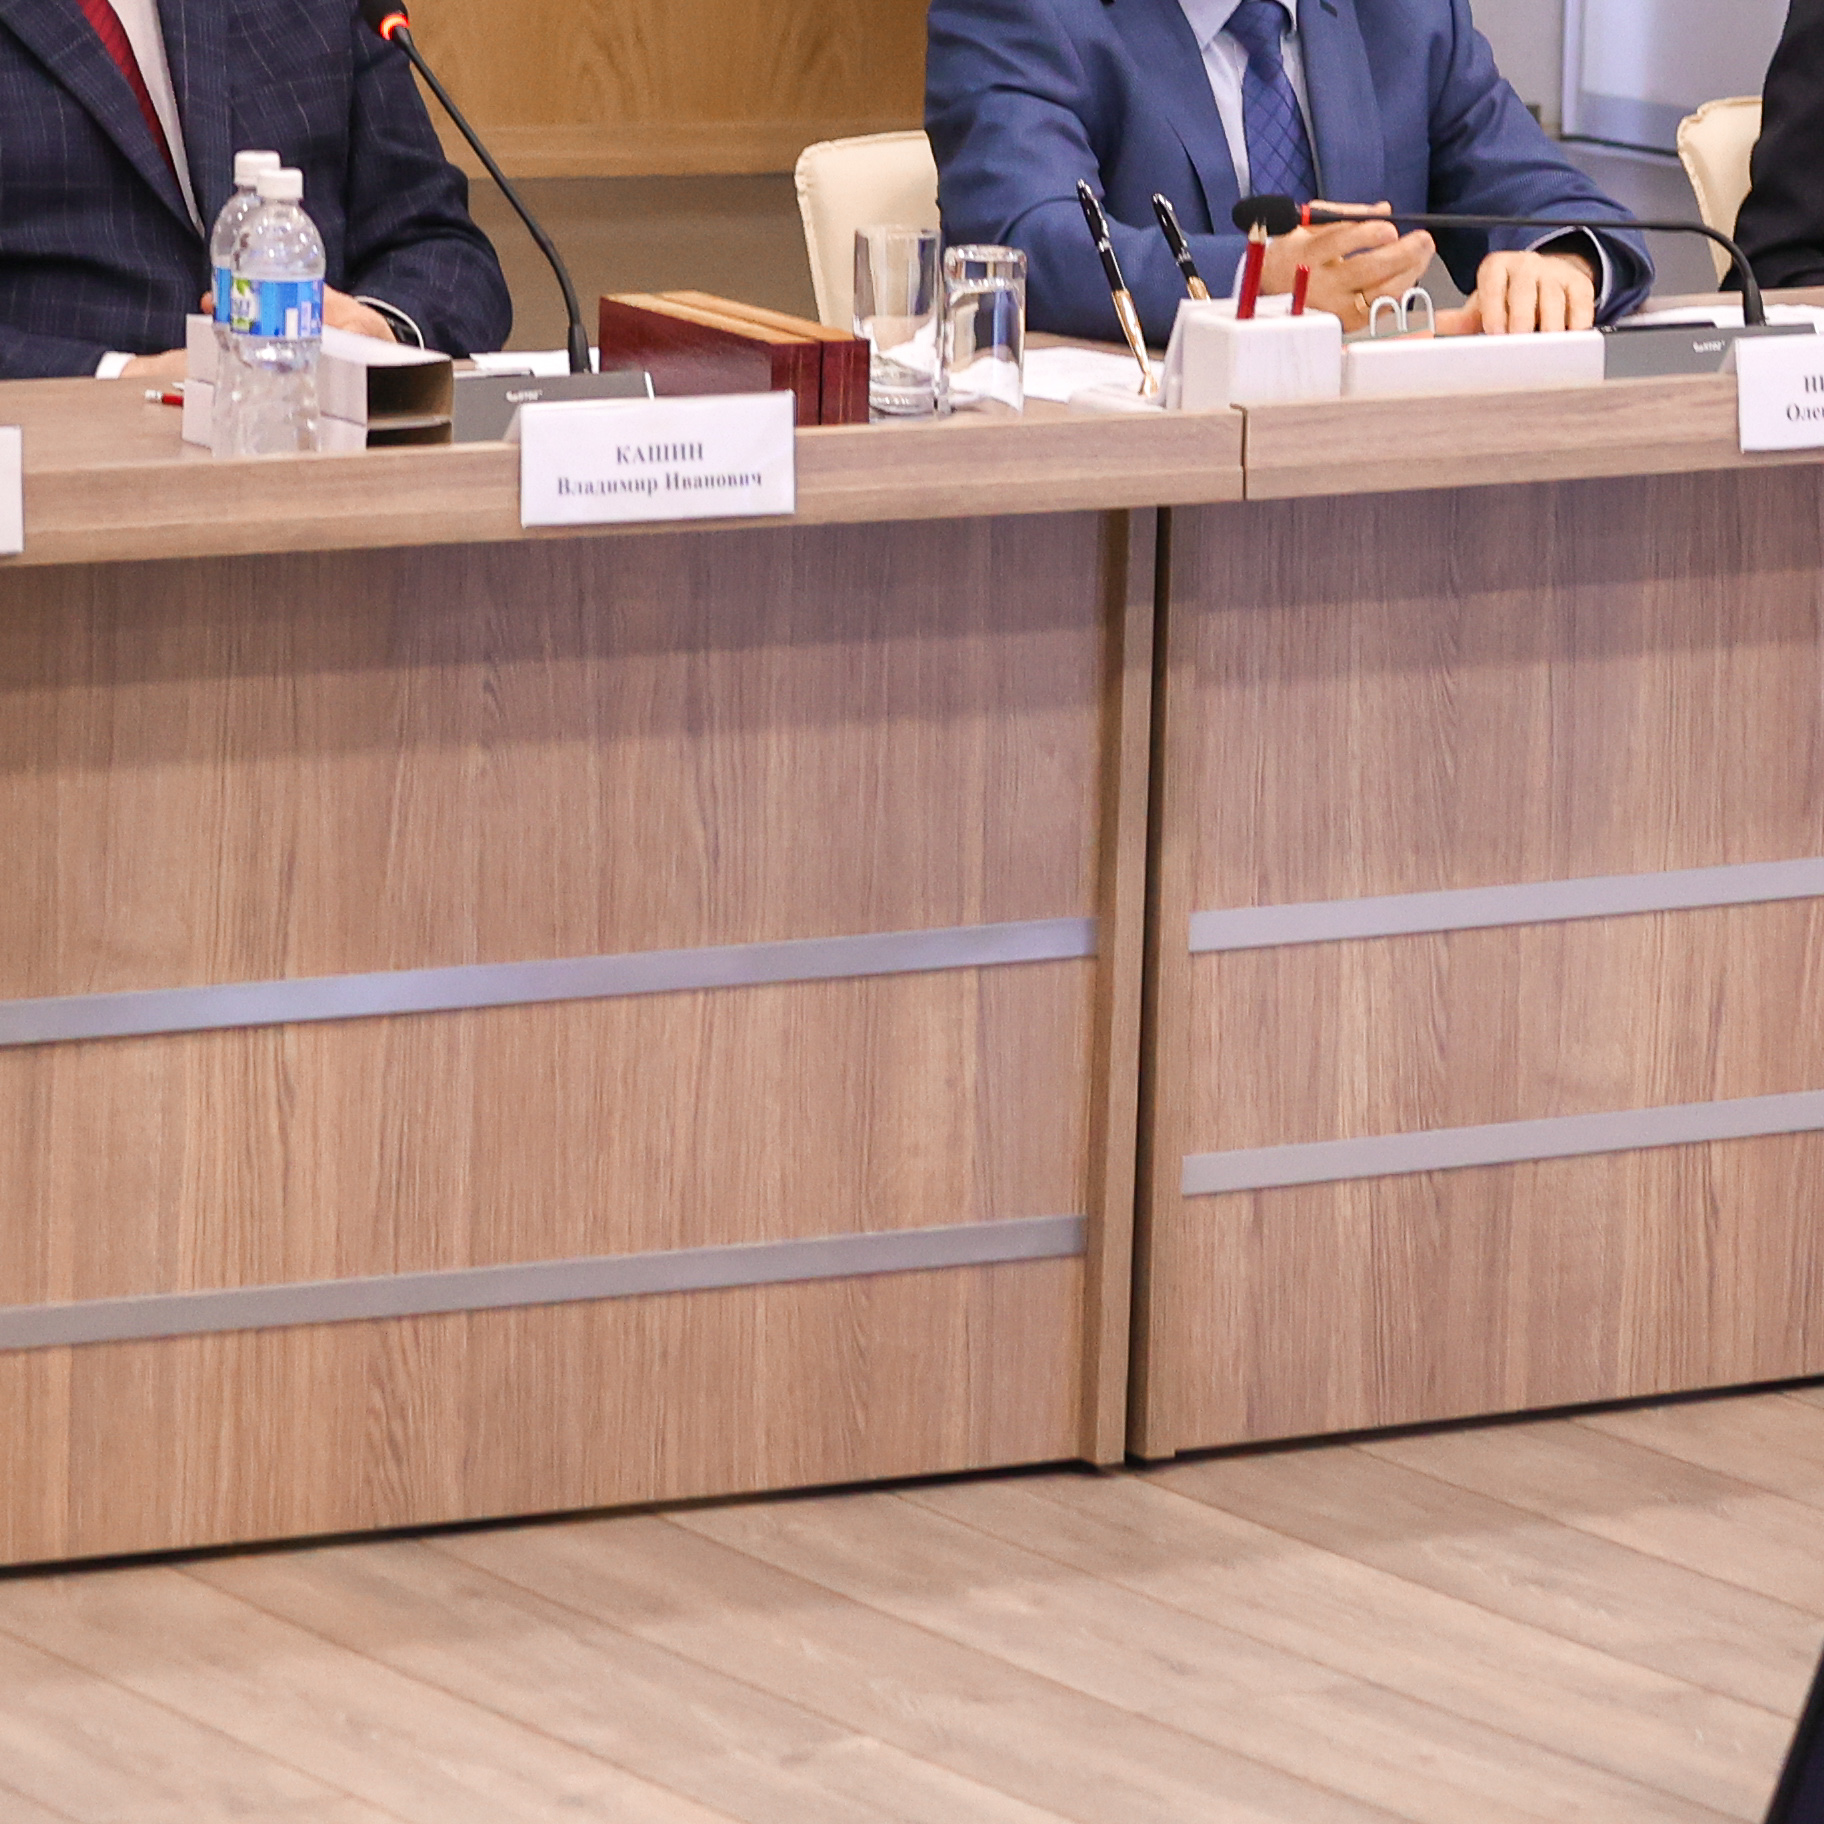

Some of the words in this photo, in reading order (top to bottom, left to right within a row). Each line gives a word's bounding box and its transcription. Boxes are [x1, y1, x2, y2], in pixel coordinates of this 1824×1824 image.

[616, 442, 704, 465] КАШИН
[557, 476, 658, 498] Владимир
[665, 471, 763, 491] Иванович
